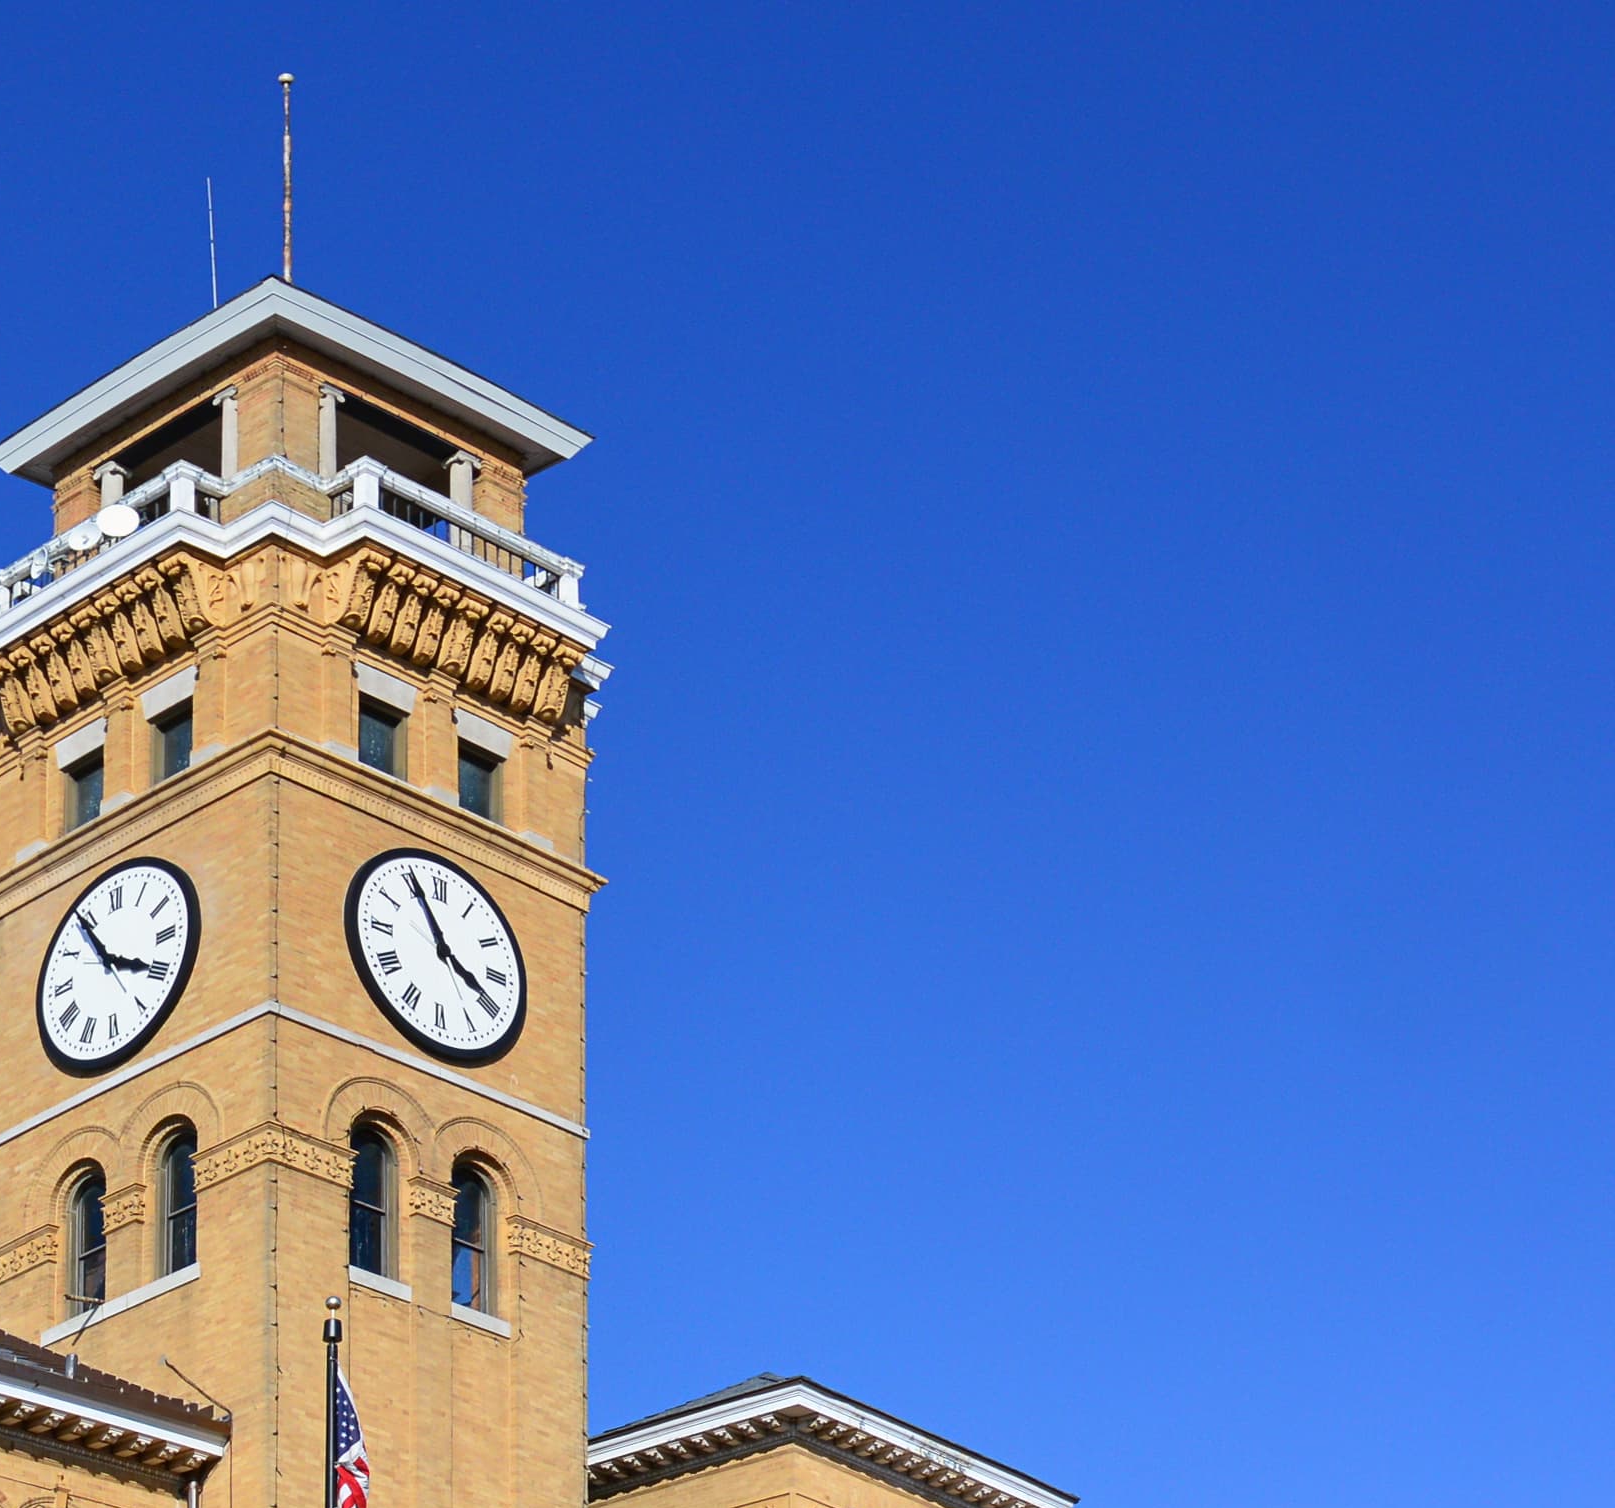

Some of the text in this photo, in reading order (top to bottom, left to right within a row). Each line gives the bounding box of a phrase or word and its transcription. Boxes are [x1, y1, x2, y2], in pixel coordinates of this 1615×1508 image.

[108, 886, 123, 915] XII
[135, 882, 147, 907] I
[379, 887, 401, 911] X
[432, 876, 448, 905] XII
[150, 895, 170, 919] II
[462, 901, 474, 919] I
[156, 924, 176, 945] III
[371, 916, 394, 938] IX
[478, 936, 499, 948] II
[376, 949, 402, 976] VIII
[55, 977, 73, 998] IX
[486, 965, 507, 987] III
[134, 995, 147, 1015] V
[401, 981, 422, 1011] VII
[59, 1000, 81, 1032] VIII
[108, 1013, 119, 1040] VI
[435, 1002, 447, 1030] VI
[462, 1007, 477, 1033] V
[80, 1016, 97, 1044] VII
